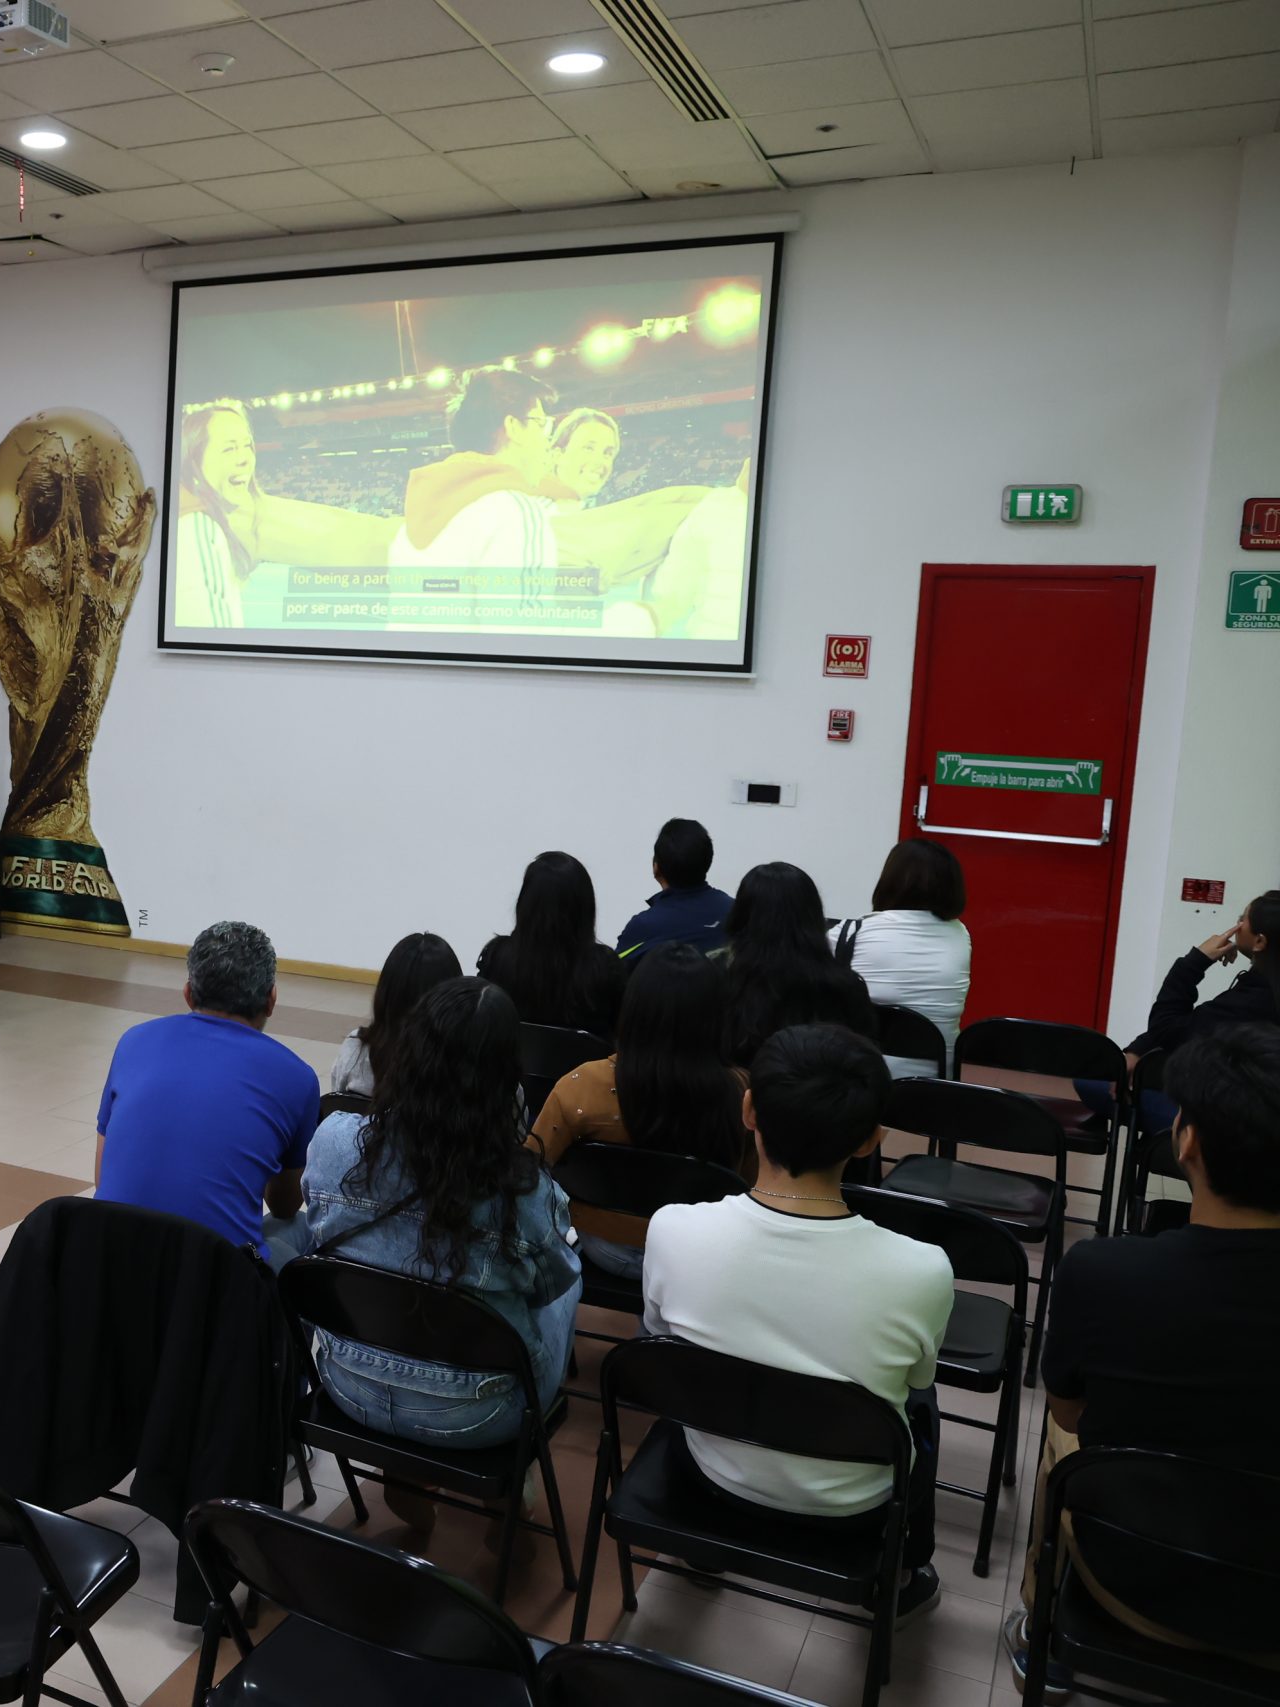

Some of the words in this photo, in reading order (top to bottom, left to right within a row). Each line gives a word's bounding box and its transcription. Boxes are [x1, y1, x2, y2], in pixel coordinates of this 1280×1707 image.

[293, 571, 311, 585] for
[314, 572, 350, 588] being
[351, 574, 360, 585] a
[363, 573, 389, 588] part
[524, 574, 593, 588] volunteer
[286, 603, 308, 617] por
[310, 603, 331, 615] ser
[334, 602, 368, 618] parte
[371, 602, 388, 616] de
[391, 604, 419, 616] este
[421, 603, 472, 617] camino
[474, 606, 513, 618] como
[515, 604, 598, 620] voluntarios
[1238, 614, 1267, 622] ZONA
[829, 660, 864, 669] ALARMA
[831, 710, 850, 718] FIRE
[971, 771, 998, 787] Empuje
[1008, 774, 1027, 786] barra
[1028, 776, 1045, 789] para
[1046, 776, 1065, 789] abrir
[11, 856, 91, 879] FIFA
[72, 877, 110, 898] CUP
[138, 909, 149, 928] TM
